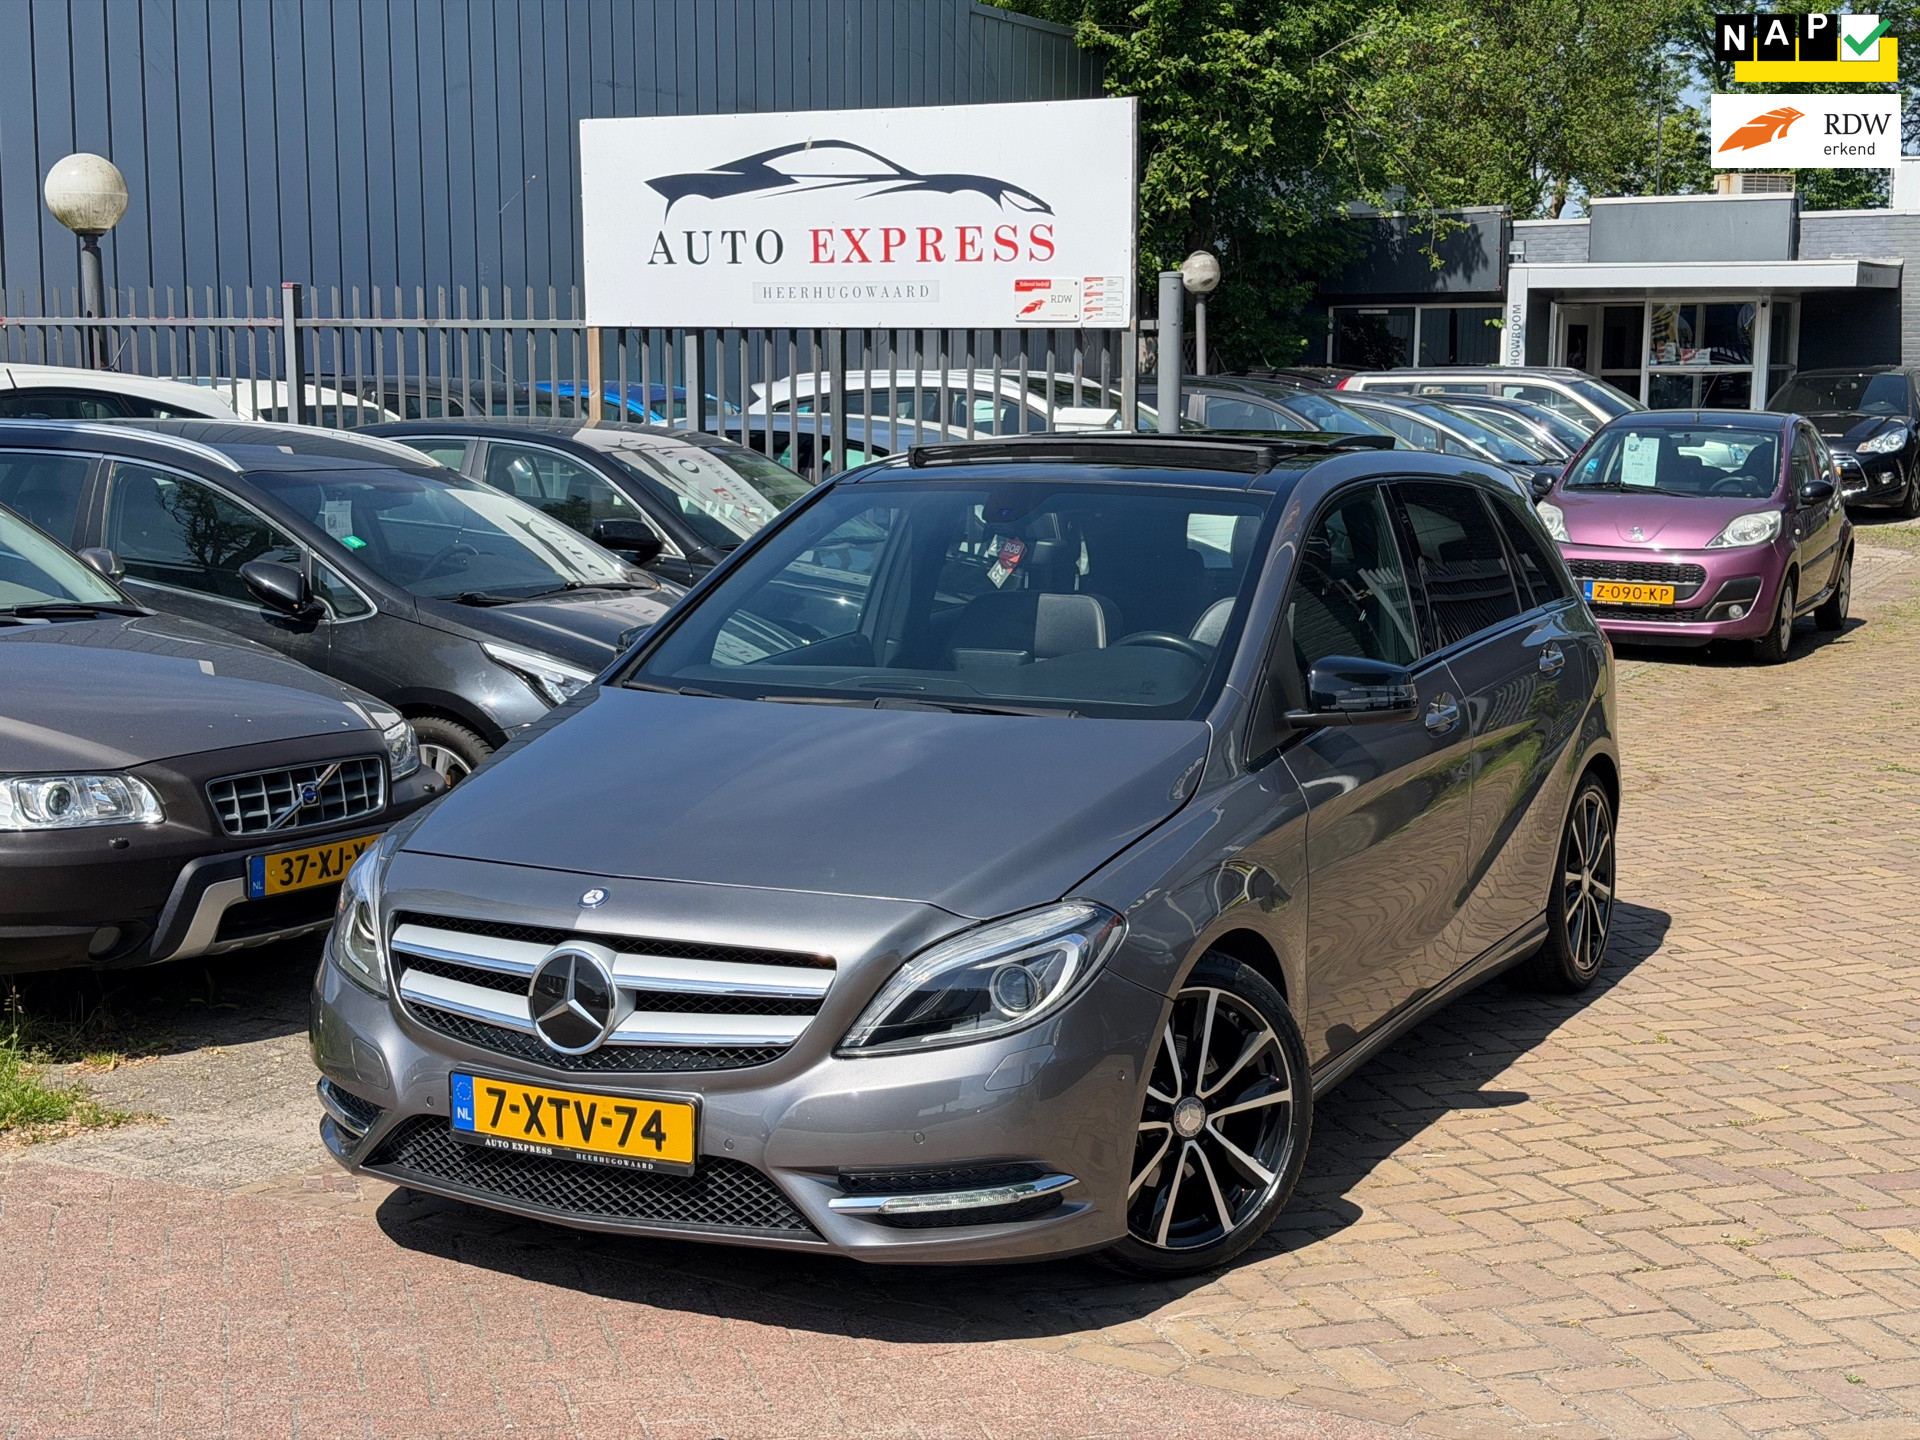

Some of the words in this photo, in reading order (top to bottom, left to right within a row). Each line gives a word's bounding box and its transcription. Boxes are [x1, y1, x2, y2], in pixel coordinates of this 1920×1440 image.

[647, 229, 784, 266] AUTO
[808, 223, 1056, 264] EXPRESS
[762, 284, 931, 300] HEERHUGOWAARD
[1050, 294, 1073, 304] RDW
[1510, 304, 1522, 366] HOWROOM
[1004, 542, 1021, 554] BOB
[1596, 585, 1669, 601] Z-090-KP
[252, 881, 263, 891] NL
[280, 840, 376, 886] 37-XJ-X
[457, 1106, 472, 1121] NL
[486, 1087, 667, 1152] 7-XTV-74
[485, 1138, 509, 1150] AUTO
[512, 1142, 553, 1156] EXPRESS
[576, 1153, 654, 1170] HEERHUGOWAARD
